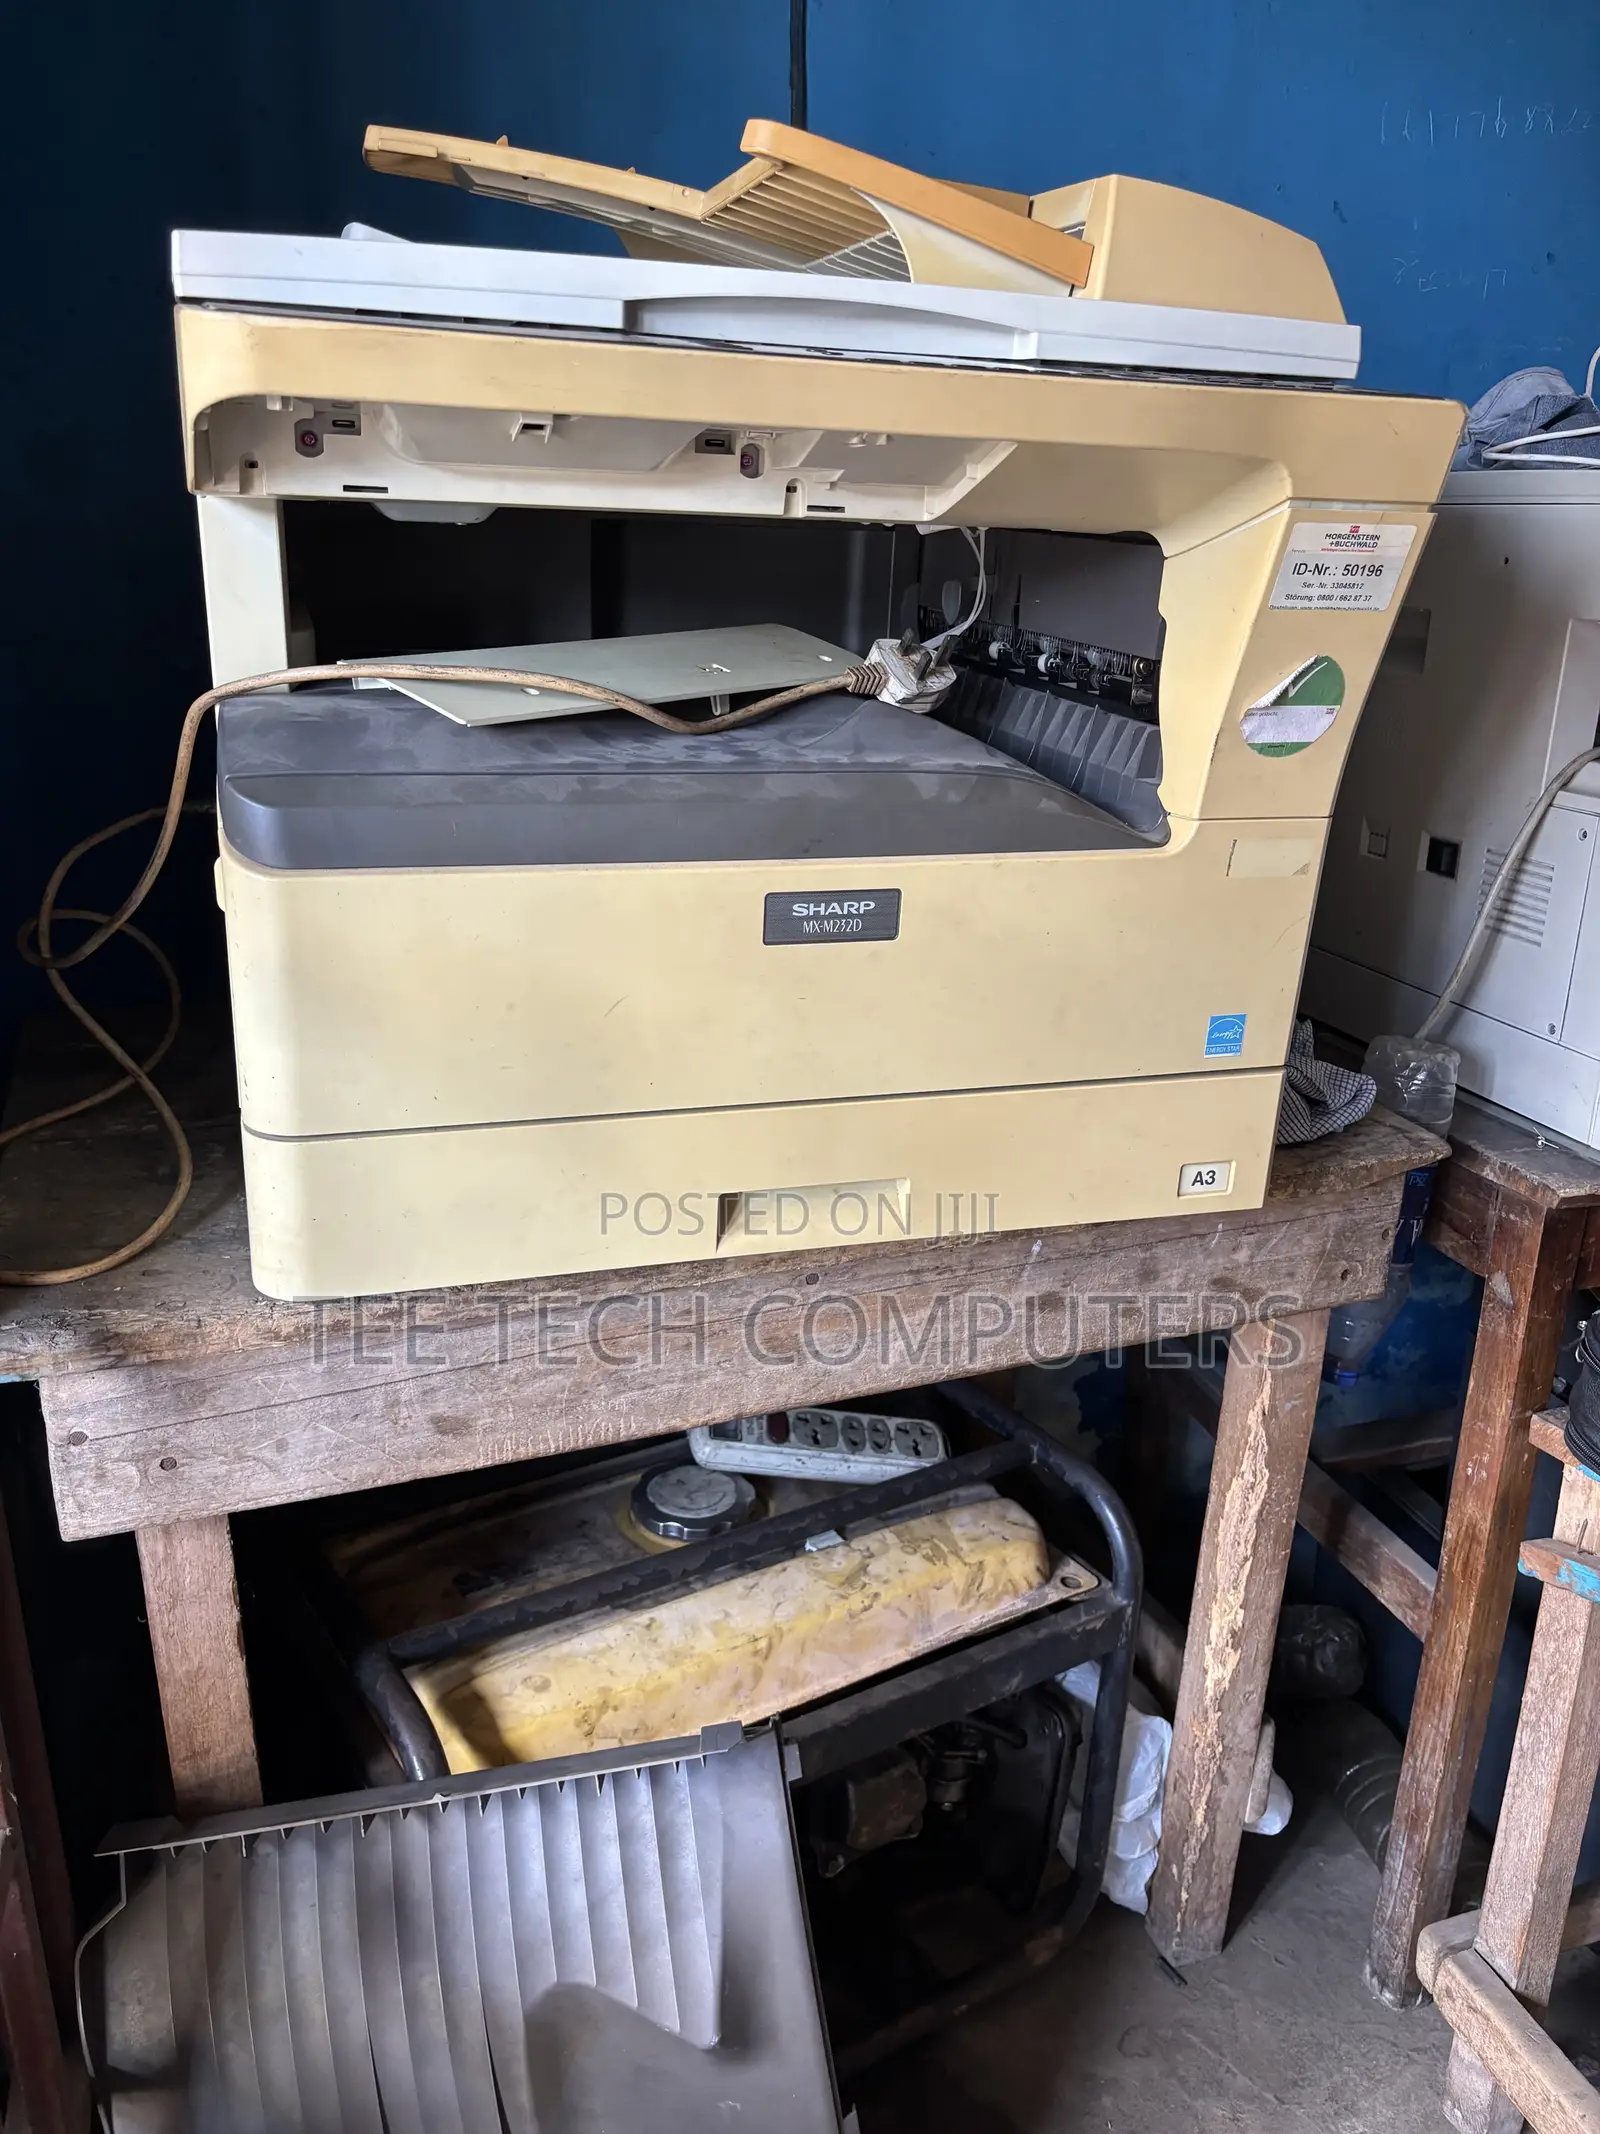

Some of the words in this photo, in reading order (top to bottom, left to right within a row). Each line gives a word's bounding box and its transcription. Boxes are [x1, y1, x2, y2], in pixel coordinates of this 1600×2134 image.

[1324, 533, 1381, 541] MORGENSTERN
[1329, 540, 1378, 549] +BUCHWALD
[1292, 562, 1338, 576] ID-Nr.:
[1341, 563, 1384, 577] 50196
[1284, 593, 1317, 602] Störung:
[791, 900, 876, 917] SHARP
[803, 918, 863, 934] MX-M232D
[1206, 1046, 1227, 1054] ENERGY
[1227, 1045, 1240, 1053] STAR
[1191, 1169, 1217, 1187] A3
